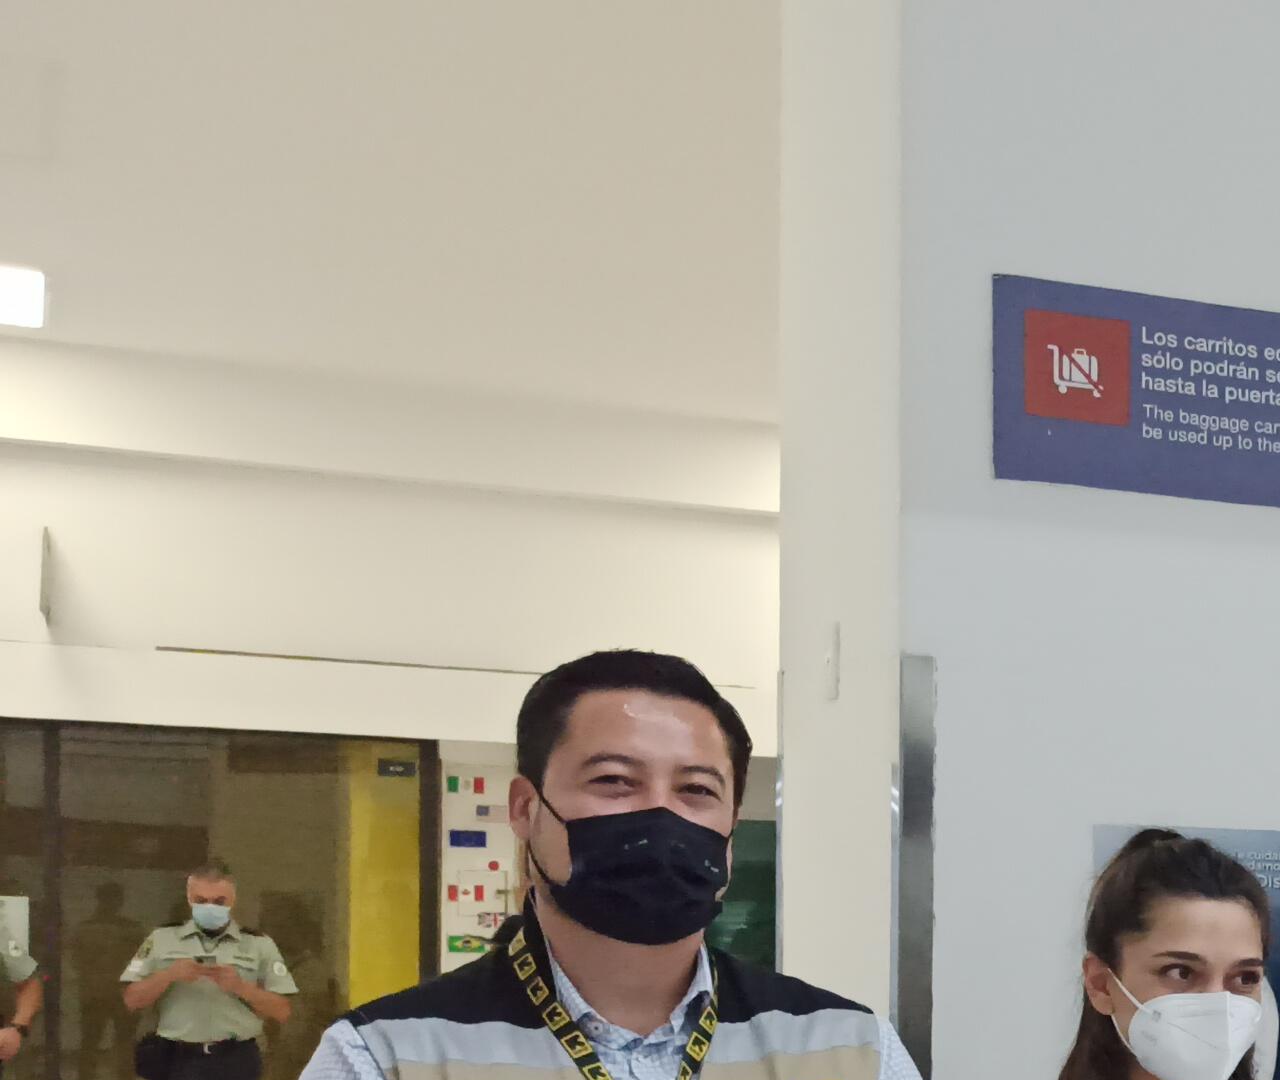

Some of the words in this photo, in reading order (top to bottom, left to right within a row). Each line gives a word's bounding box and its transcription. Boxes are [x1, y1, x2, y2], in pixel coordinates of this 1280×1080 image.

[1141, 326, 1178, 348] Los
[1184, 336, 1259, 359] carritos
[1141, 350, 1184, 371] sólo
[1189, 359, 1260, 382] podrán
[1141, 371, 1197, 396] hasta
[1202, 378, 1219, 399] la
[1142, 403, 1174, 422] The
[1179, 408, 1250, 433] baggage
[1142, 422, 1163, 439] be
[1168, 428, 1208, 445] used
[1213, 434, 1233, 451] up
[1237, 435, 1253, 450] to
